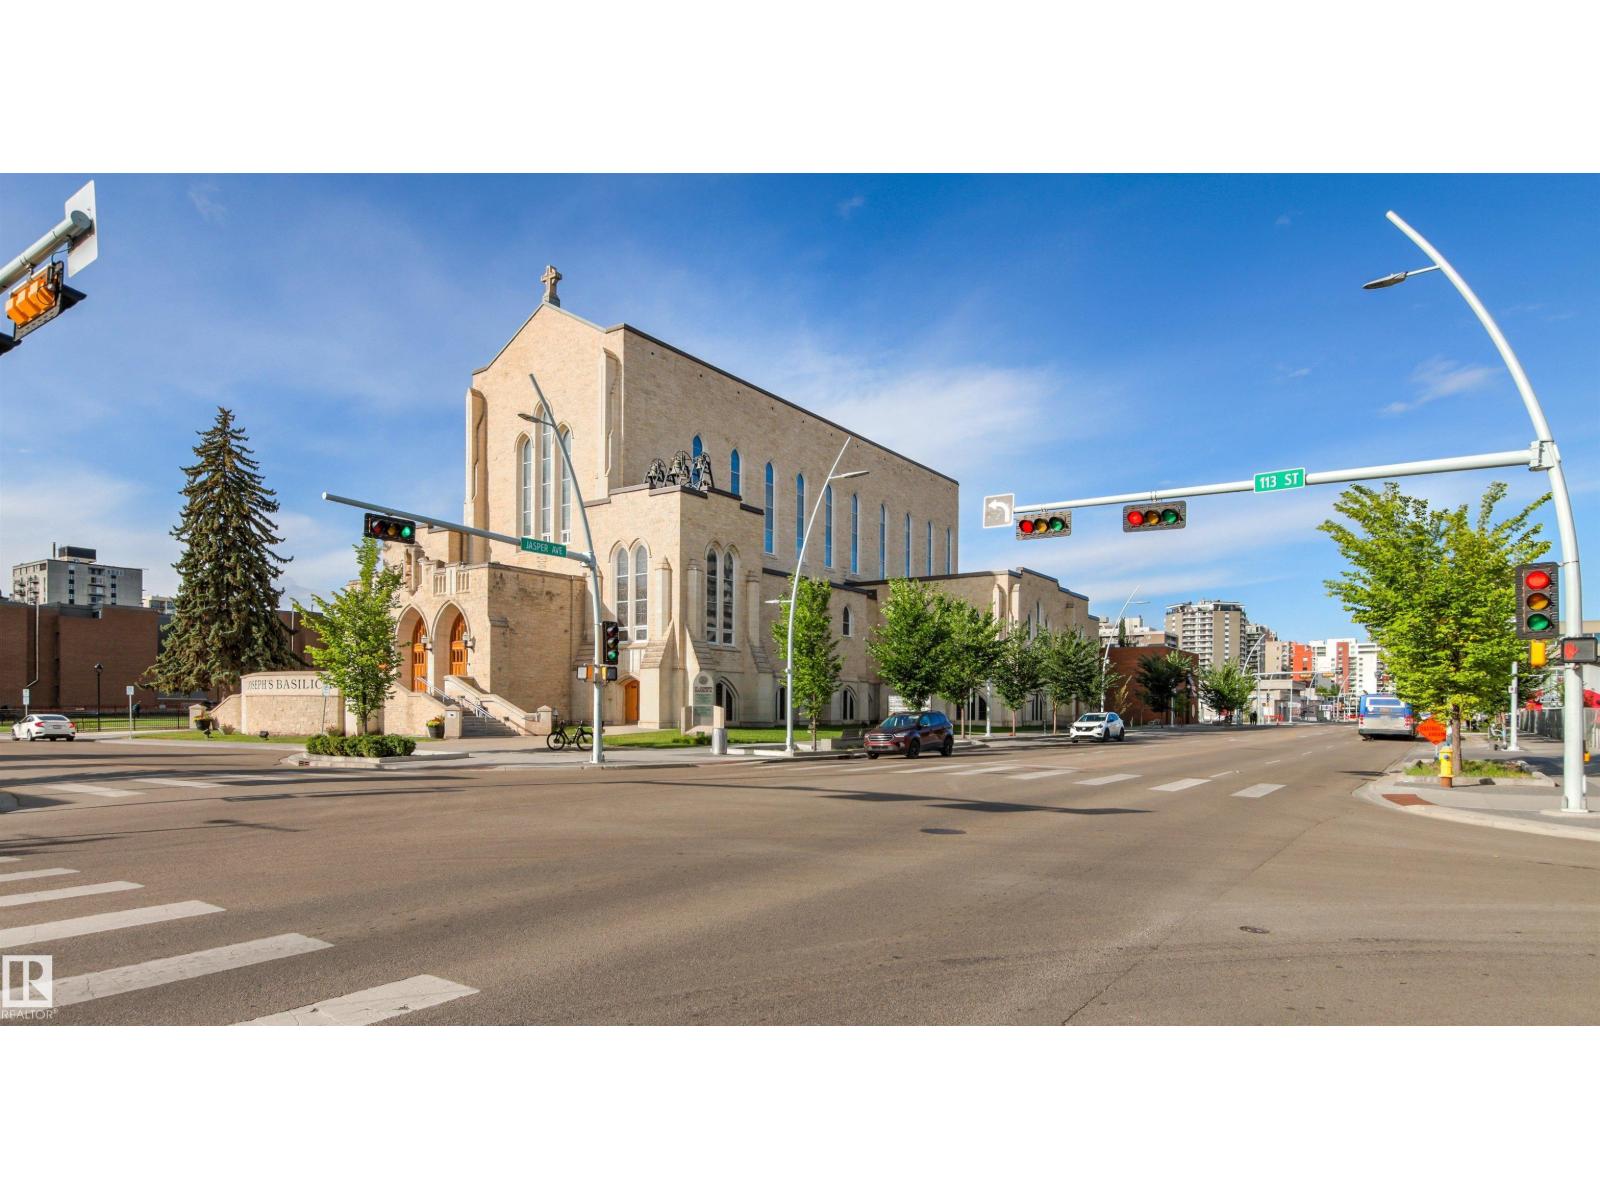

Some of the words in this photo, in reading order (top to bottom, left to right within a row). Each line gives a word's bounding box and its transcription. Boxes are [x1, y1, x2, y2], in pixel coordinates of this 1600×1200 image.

[1260, 475, 1277, 489] 113
[1284, 472, 1299, 486] ST
[525, 540, 549, 552] JASPER
[551, 546, 563, 555] AVE
